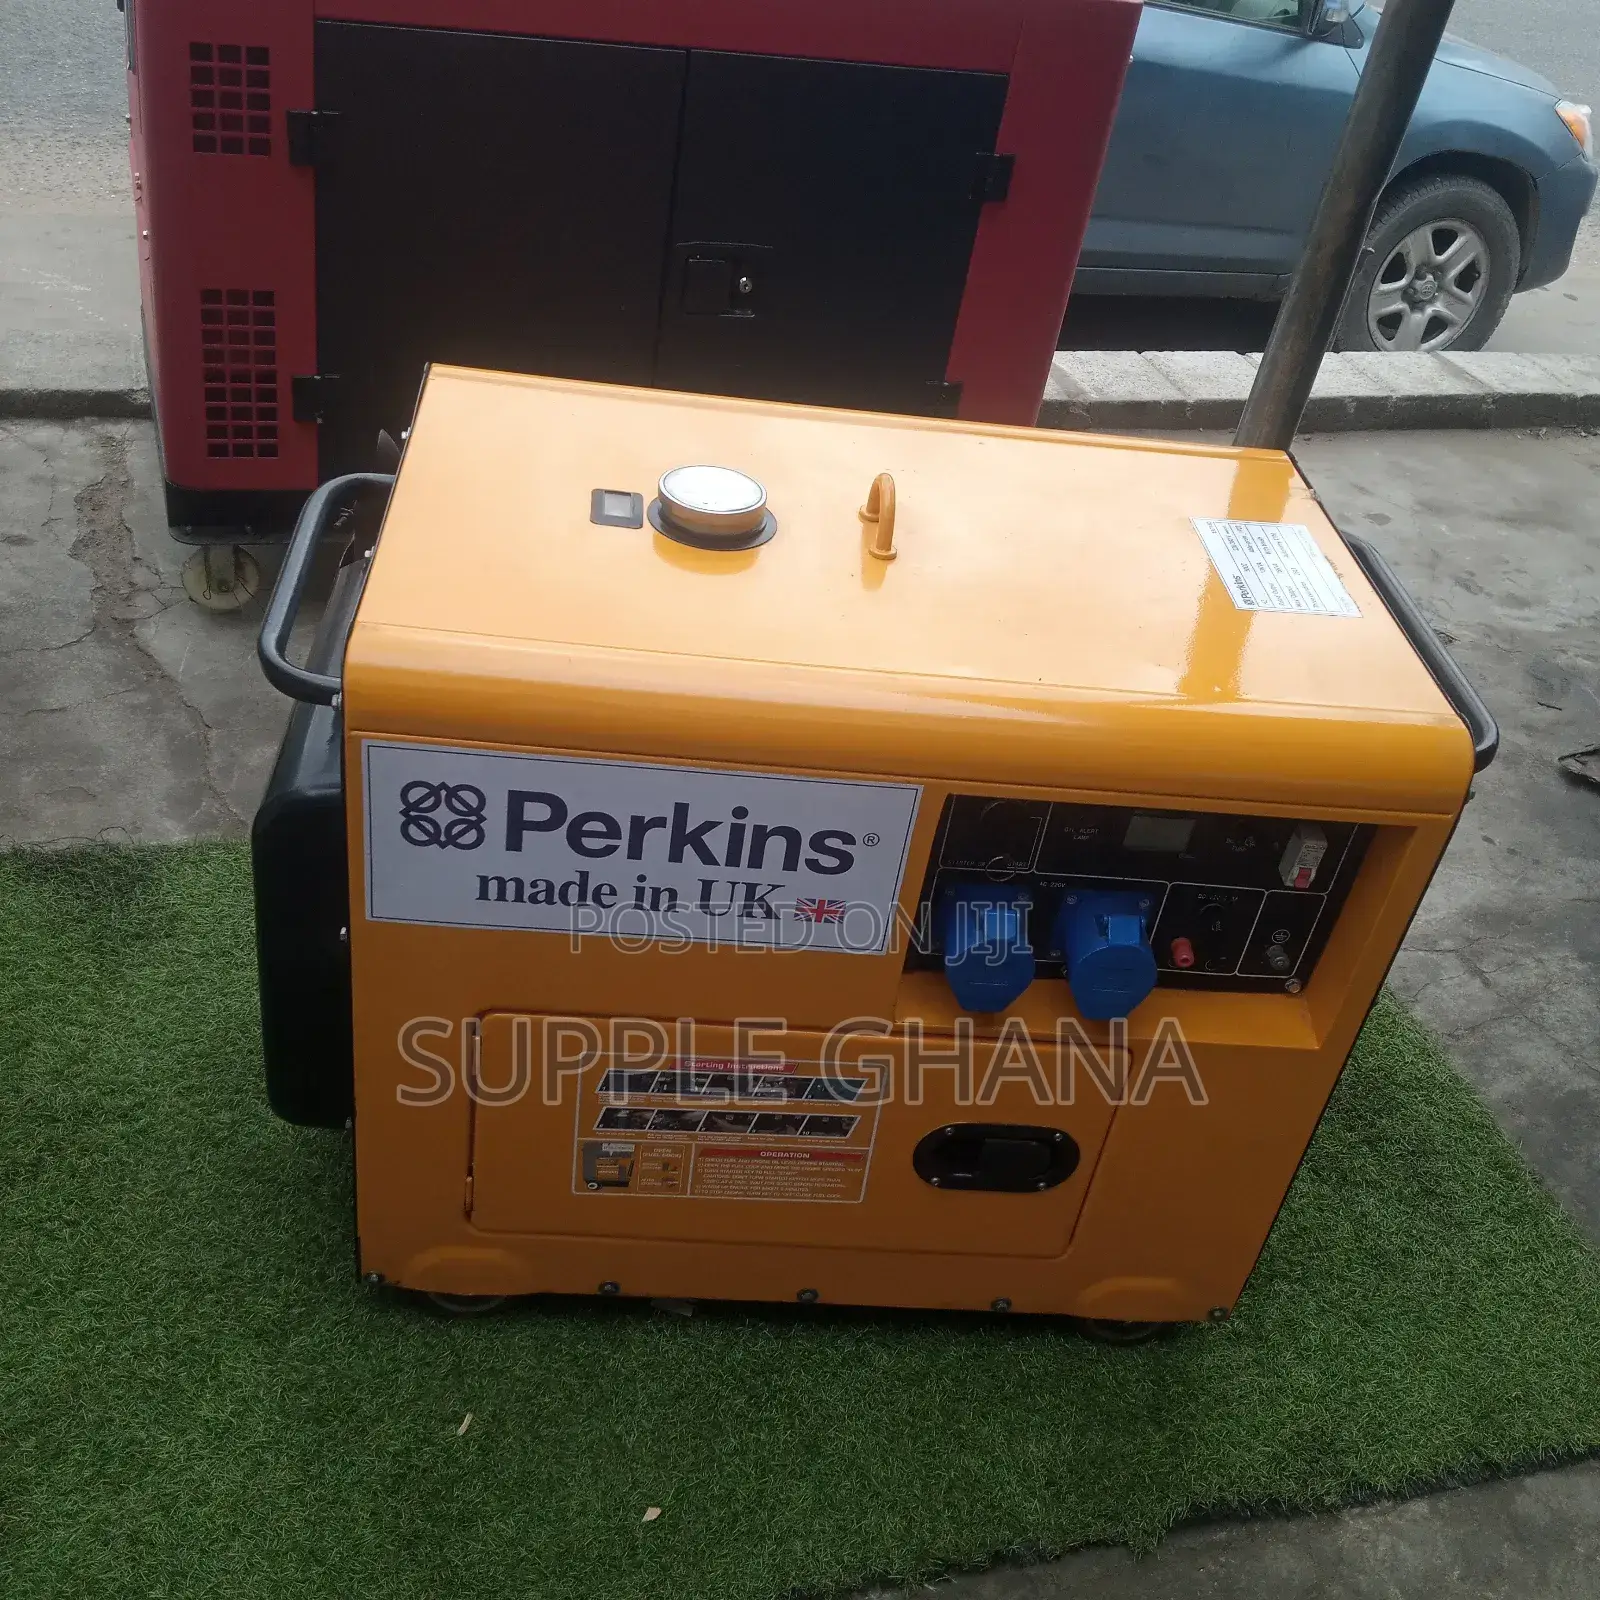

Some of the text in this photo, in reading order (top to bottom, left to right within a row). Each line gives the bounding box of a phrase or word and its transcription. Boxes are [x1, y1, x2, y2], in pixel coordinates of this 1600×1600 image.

[1232, 574, 1252, 601] Perkins
[504, 788, 858, 876] Perkins
[475, 870, 784, 920] made in UK
[684, 1060, 785, 1071] Starting Instructions
[759, 1151, 811, 1159] OPERATION
